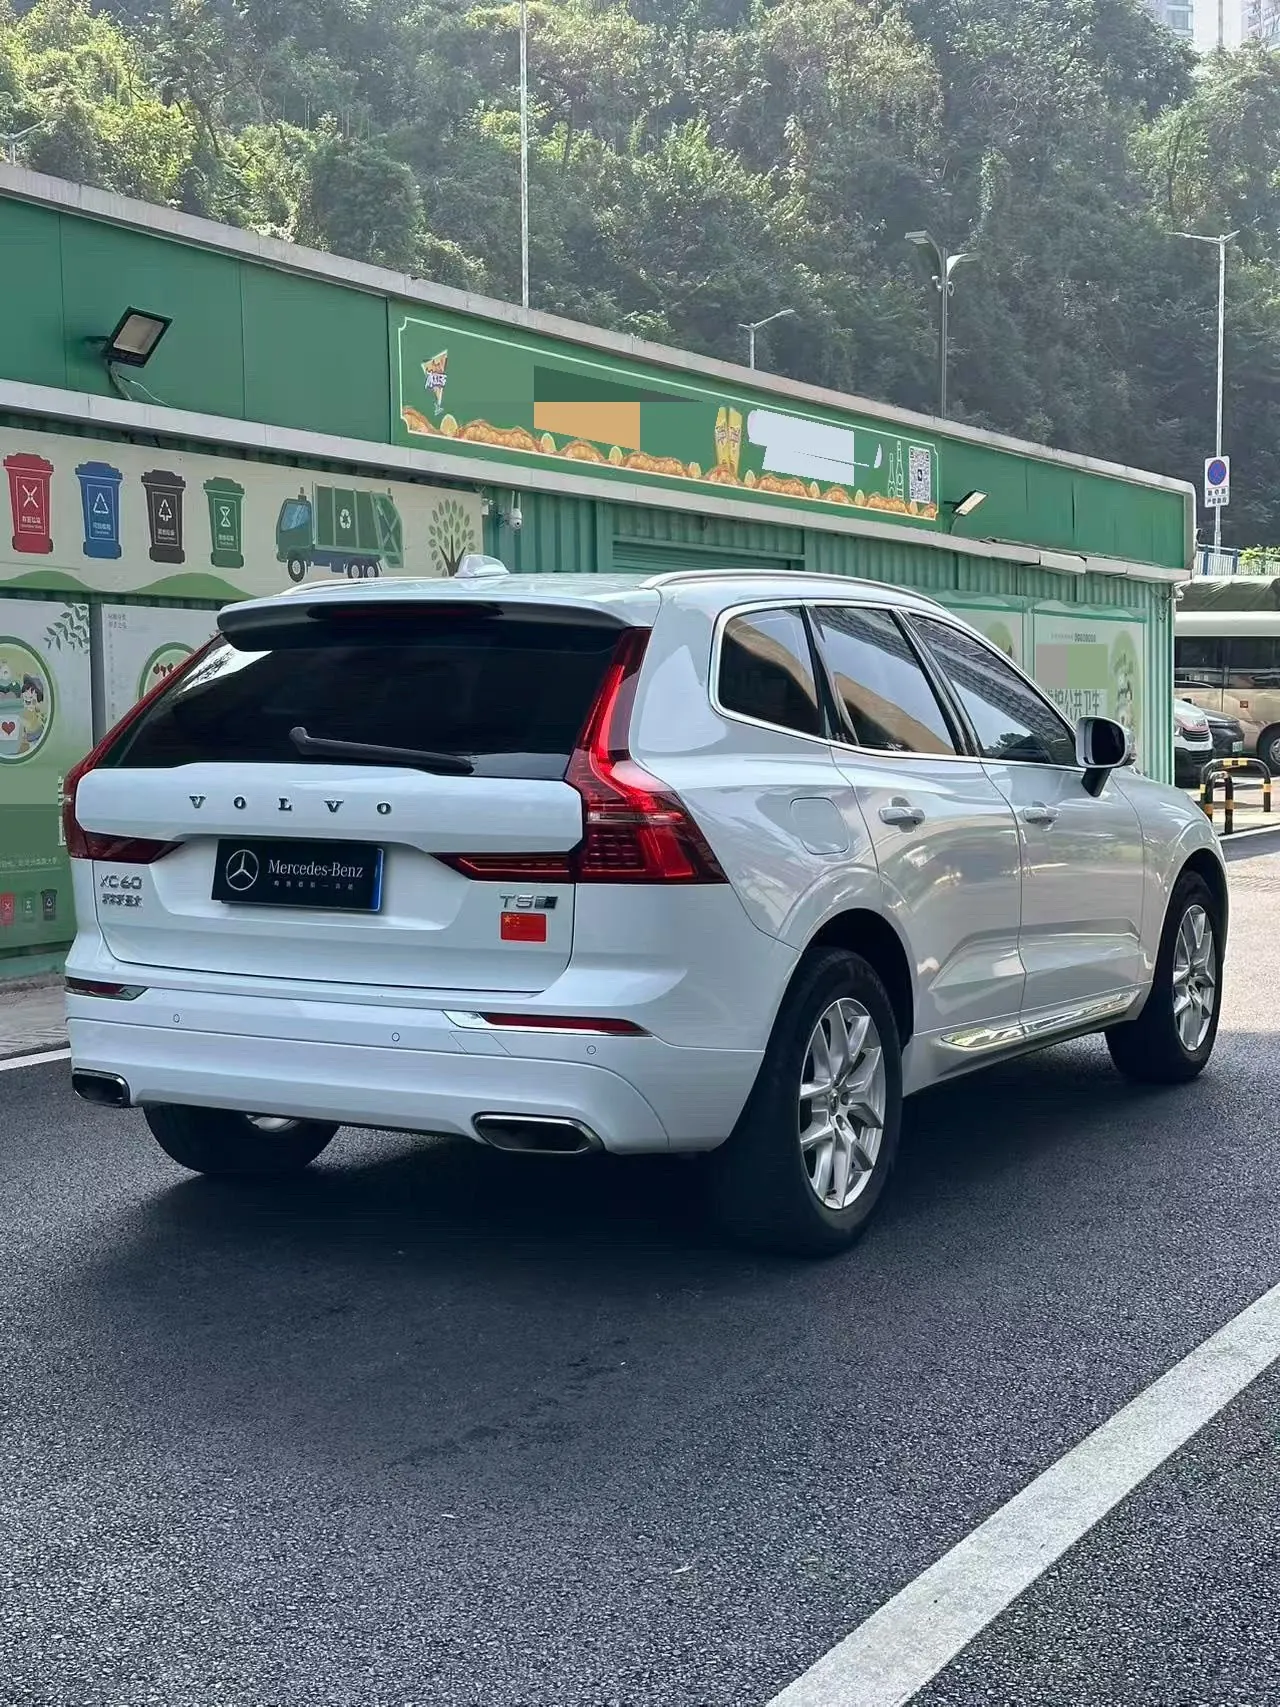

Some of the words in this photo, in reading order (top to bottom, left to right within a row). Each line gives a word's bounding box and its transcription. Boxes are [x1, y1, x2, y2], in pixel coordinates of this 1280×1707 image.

[189, 795, 393, 815] VOLVO
[267, 859, 364, 878] Mercedes-Benz
[100, 874, 143, 890] XC60
